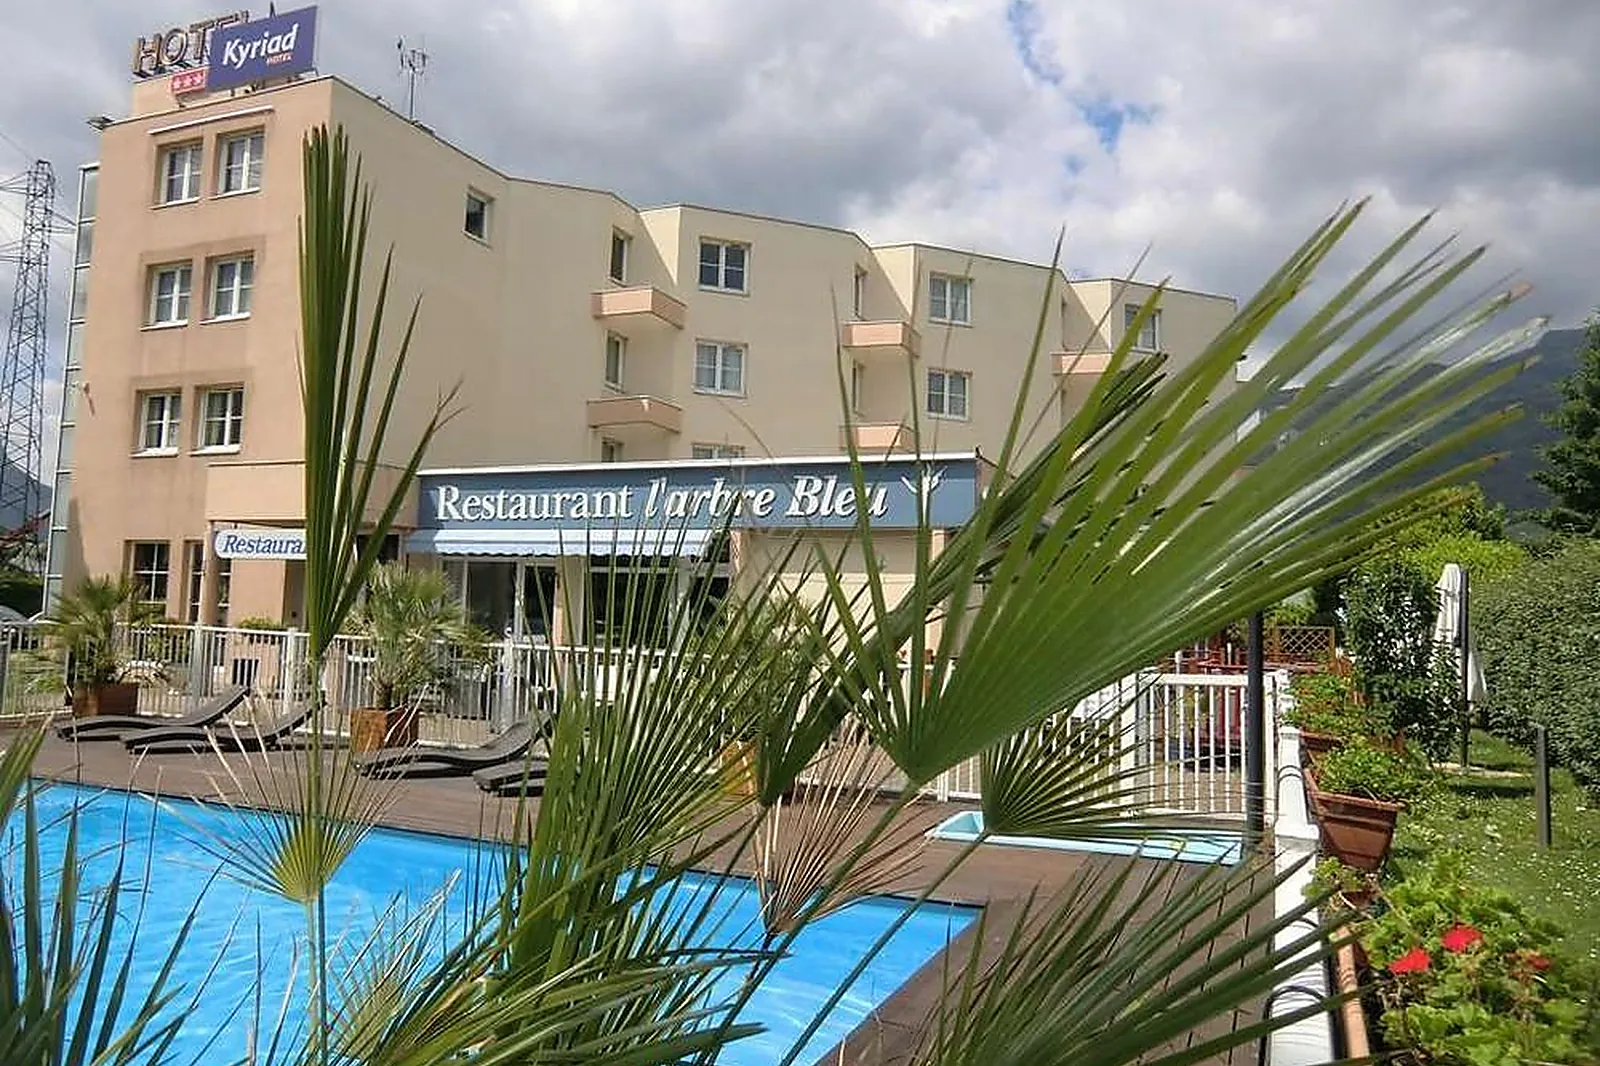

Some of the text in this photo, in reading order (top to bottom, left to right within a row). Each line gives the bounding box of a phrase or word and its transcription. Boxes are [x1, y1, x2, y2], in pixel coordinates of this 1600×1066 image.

[133, 10, 250, 78] HOT
[222, 23, 299, 69] Kyriad
[436, 475, 889, 521] Restaurant l'arbre Bleu
[223, 534, 306, 553] Restaura
